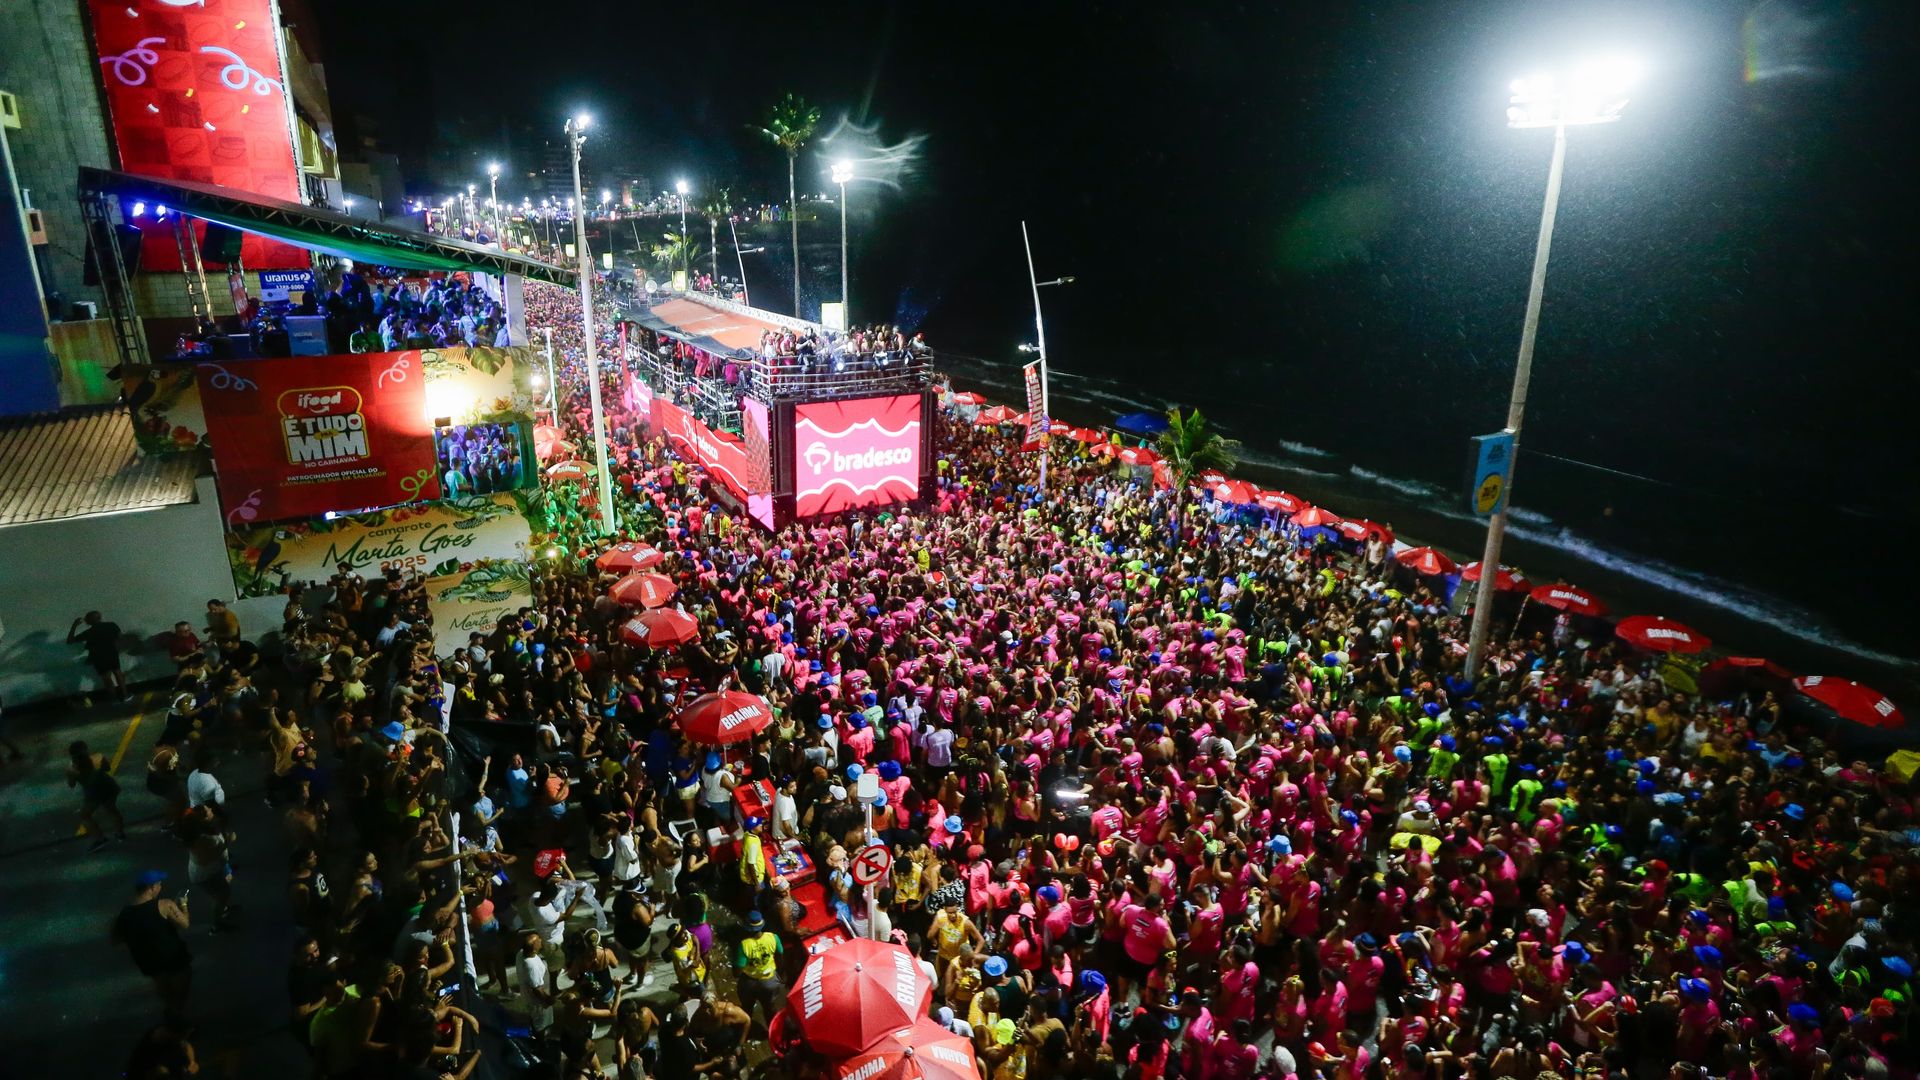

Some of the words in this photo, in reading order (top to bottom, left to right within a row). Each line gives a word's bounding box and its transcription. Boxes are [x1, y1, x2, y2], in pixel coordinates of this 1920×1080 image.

[298, 391, 342, 408] ifood
[284, 414, 300, 436] É
[301, 413, 362, 434] TUDO
[288, 430, 367, 462] MIM
[304, 461, 316, 469] NO
[317, 456, 358, 467] CARNAVAL
[834, 446, 912, 472] bradesco
[287, 470, 340, 482] PATROCINADOR
[340, 468, 366, 476] OFICIAL
[368, 521, 432, 538] camarote
[322, 533, 411, 568] Marta
[380, 554, 428, 574] 2025
[1551, 588, 1590, 607] BRAHMA
[720, 703, 762, 730] BRAHMA
[892, 950, 916, 1008] BRAHMA
